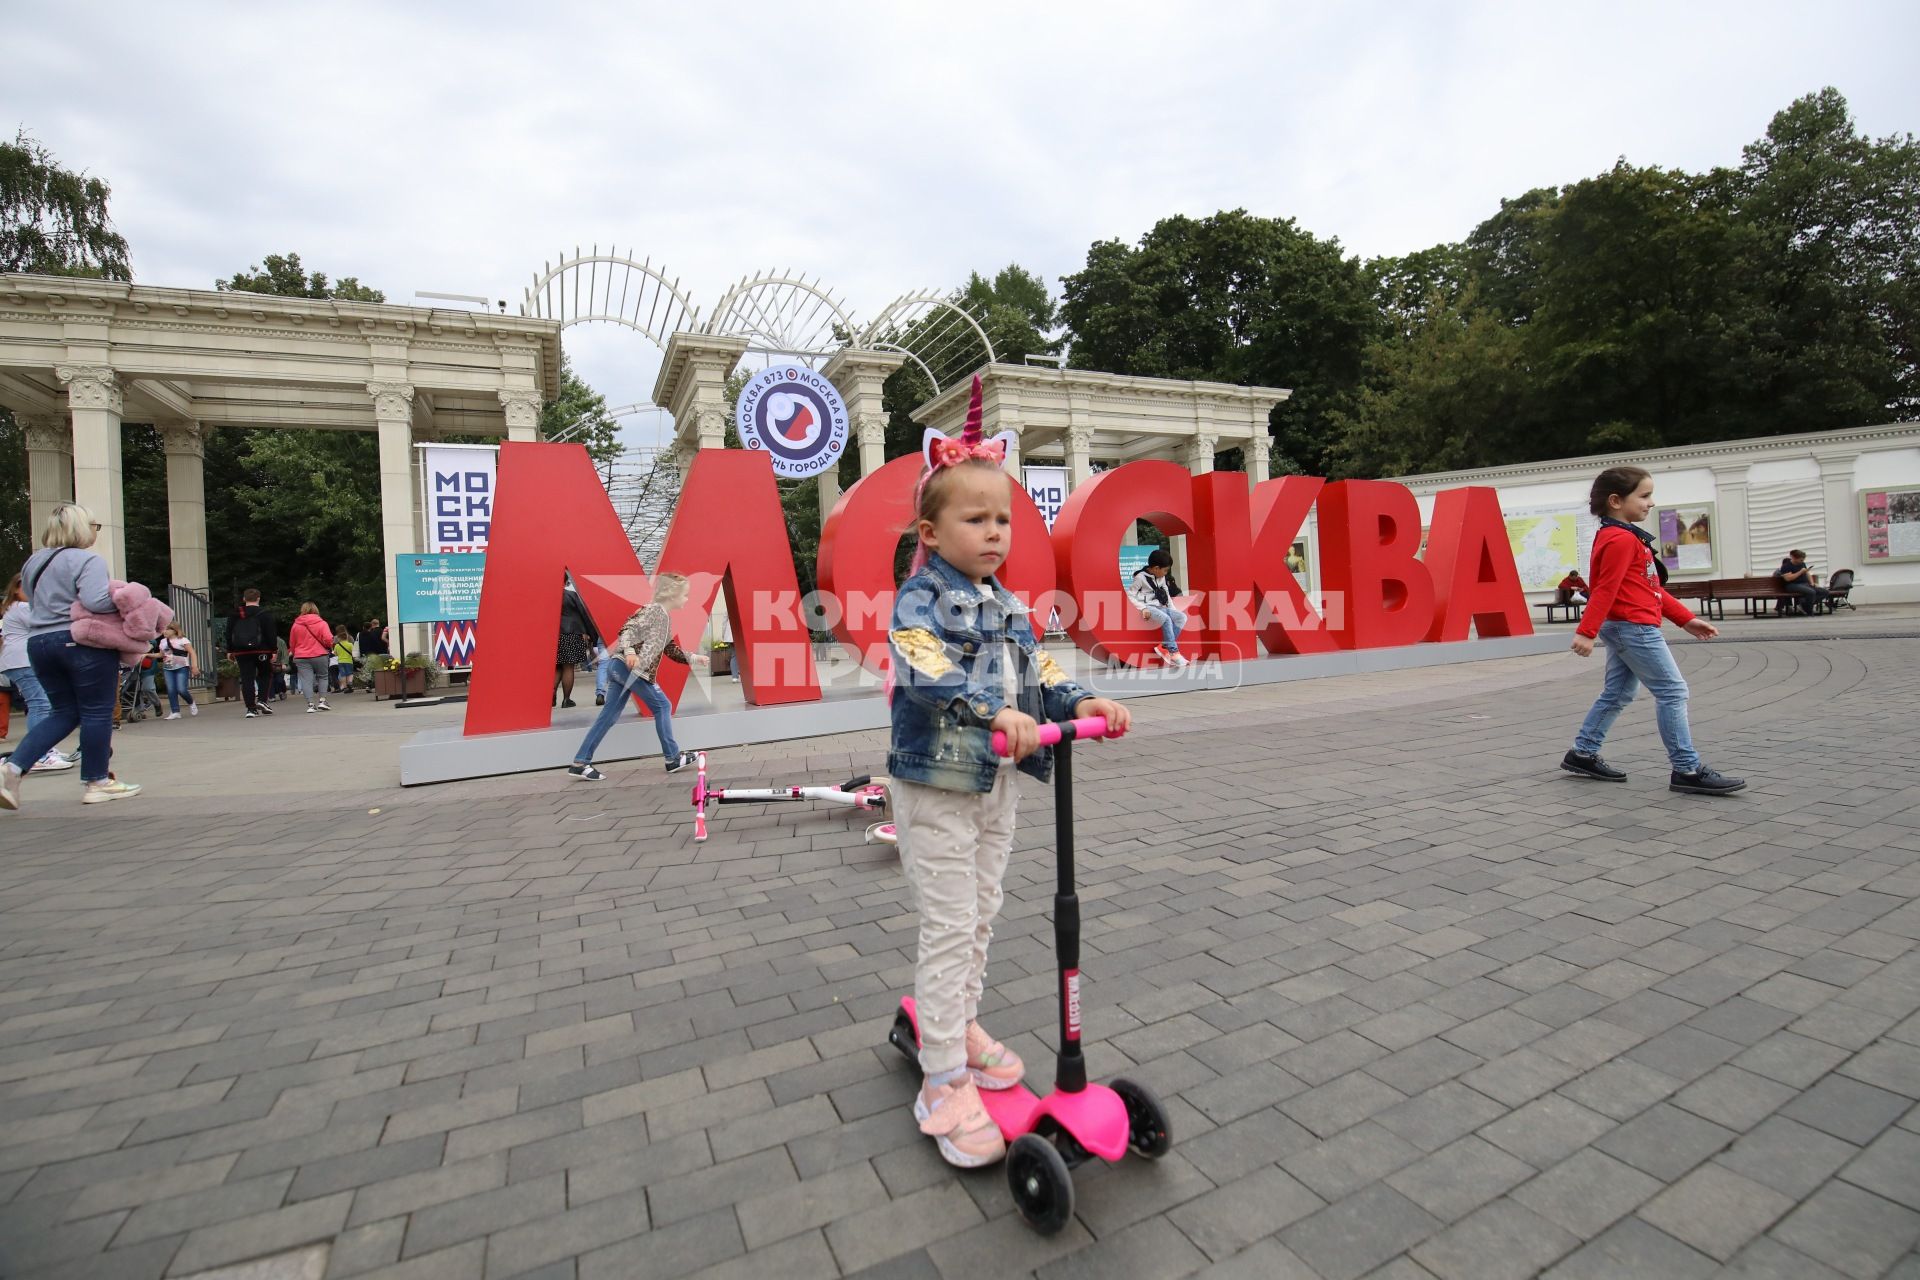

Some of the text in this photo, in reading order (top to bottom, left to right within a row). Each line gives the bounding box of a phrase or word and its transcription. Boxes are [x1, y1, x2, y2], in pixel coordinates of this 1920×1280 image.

[742, 370, 784, 434] МОСКВА 873
[800, 373, 844, 439] МОСКВА 873
[789, 452, 833, 473] ГОРОДА
[435, 471, 489, 493] МО
[436, 495, 490, 517] СК
[1031, 487, 1062, 503] МО
[437, 521, 491, 542] ВА
[462, 440, 1535, 737] МОСКВА
